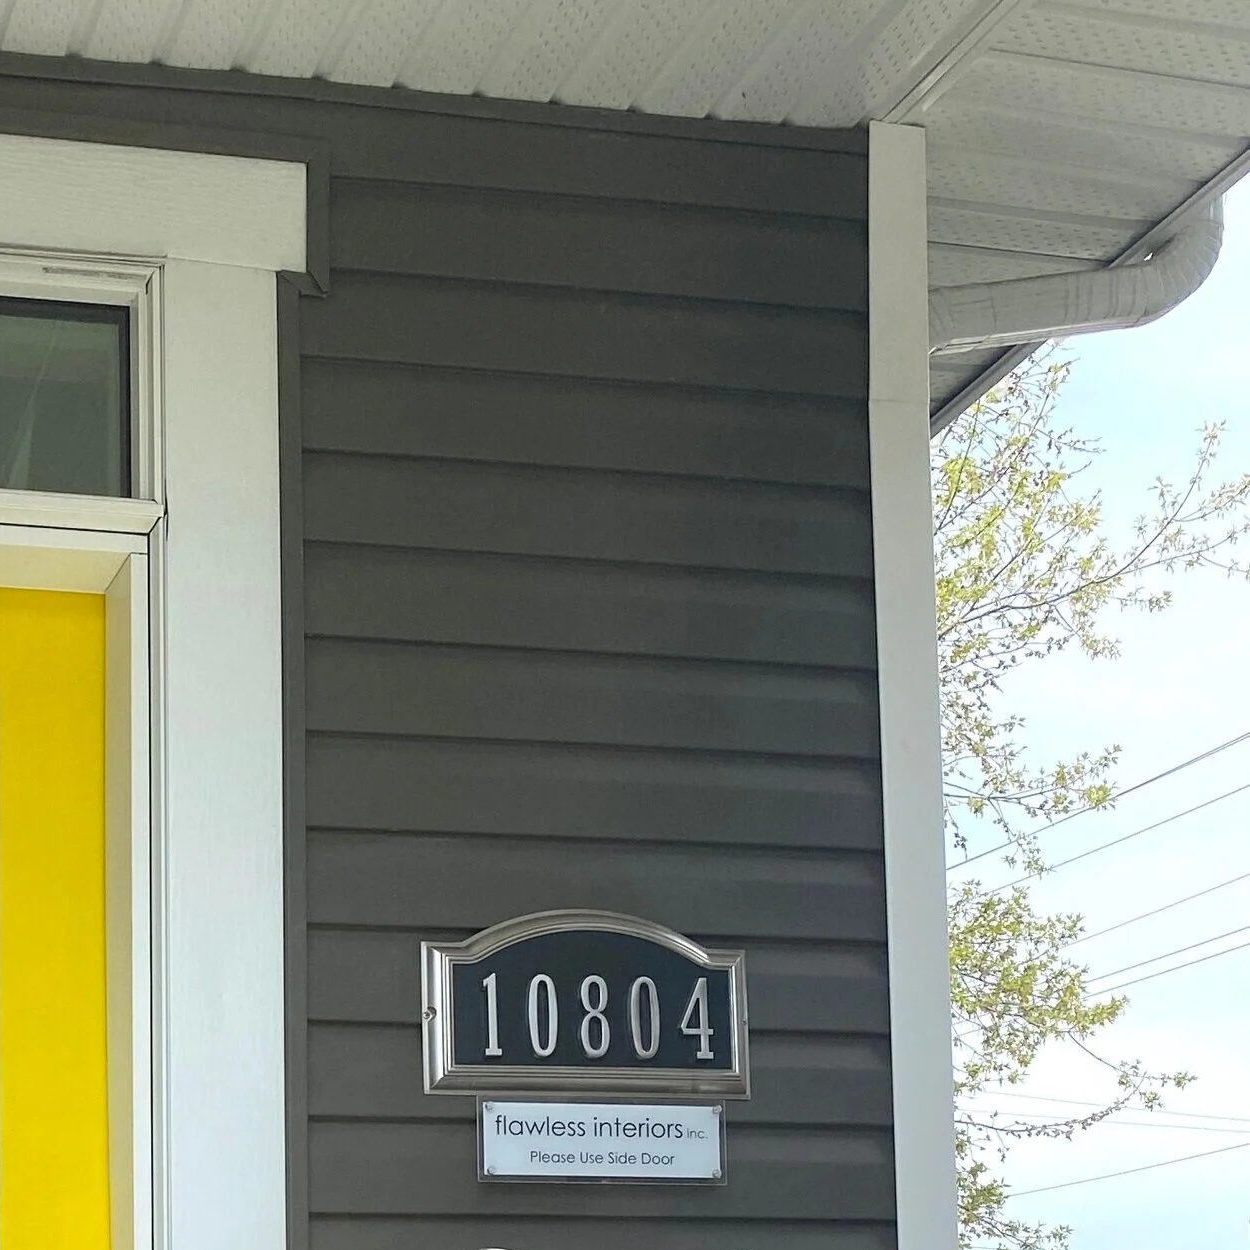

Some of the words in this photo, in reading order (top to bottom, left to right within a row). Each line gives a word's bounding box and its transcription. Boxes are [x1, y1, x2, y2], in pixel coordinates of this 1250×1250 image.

[482, 972, 714, 1060] 10804
[494, 1115, 586, 1137] flawless
[593, 1116, 683, 1139] interiors
[686, 1127, 709, 1140] inc.
[530, 1150, 576, 1164] Please
[580, 1151, 604, 1165] Use
[608, 1151, 637, 1165] Side
[641, 1152, 675, 1166] Door
